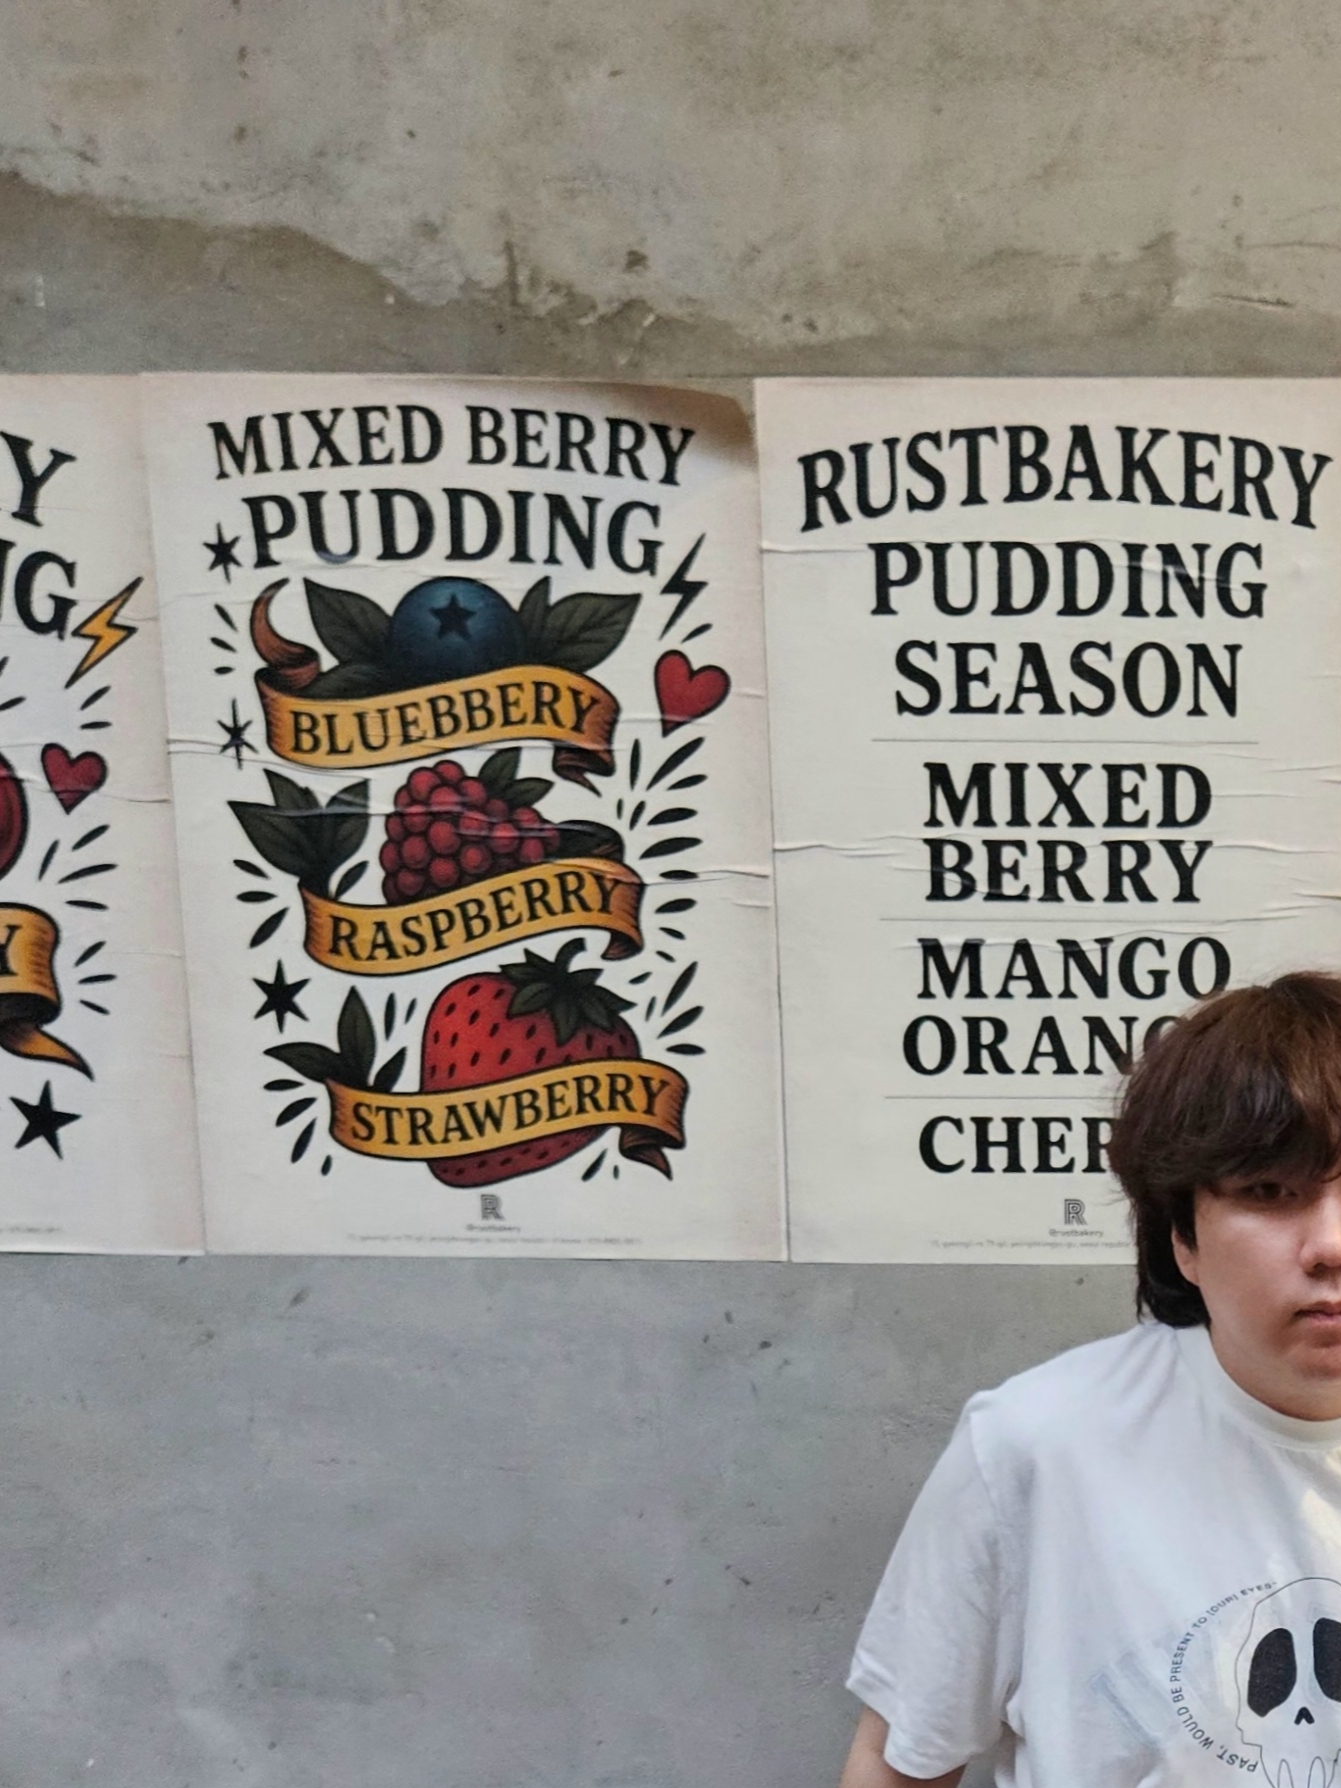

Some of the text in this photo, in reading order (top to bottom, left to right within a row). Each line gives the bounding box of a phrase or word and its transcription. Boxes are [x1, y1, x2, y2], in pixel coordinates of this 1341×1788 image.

[207, 405, 695, 487] MIXED BERRY
[798, 424, 1333, 532] RUSTBAKERY
[242, 489, 665, 578] PUDDING
[0, 538, 78, 641] G
[868, 541, 1268, 619] PUDDING
[895, 640, 1243, 718] SEASON
[290, 682, 600, 755] BLUEBBERY
[924, 762, 1213, 828] MIXED
[924, 839, 1213, 903] BERRY
[326, 868, 625, 960] RASPBERRY
[916, 937, 1232, 1000] MANGO
[350, 1077, 670, 1146] STRAWBERRY
[1169, 1632, 1195, 1682] PRESENT
[1191, 1616, 1208, 1629] TO
[1170, 1686, 1185, 1703] BE
[1176, 1706, 1215, 1750] WOULD
